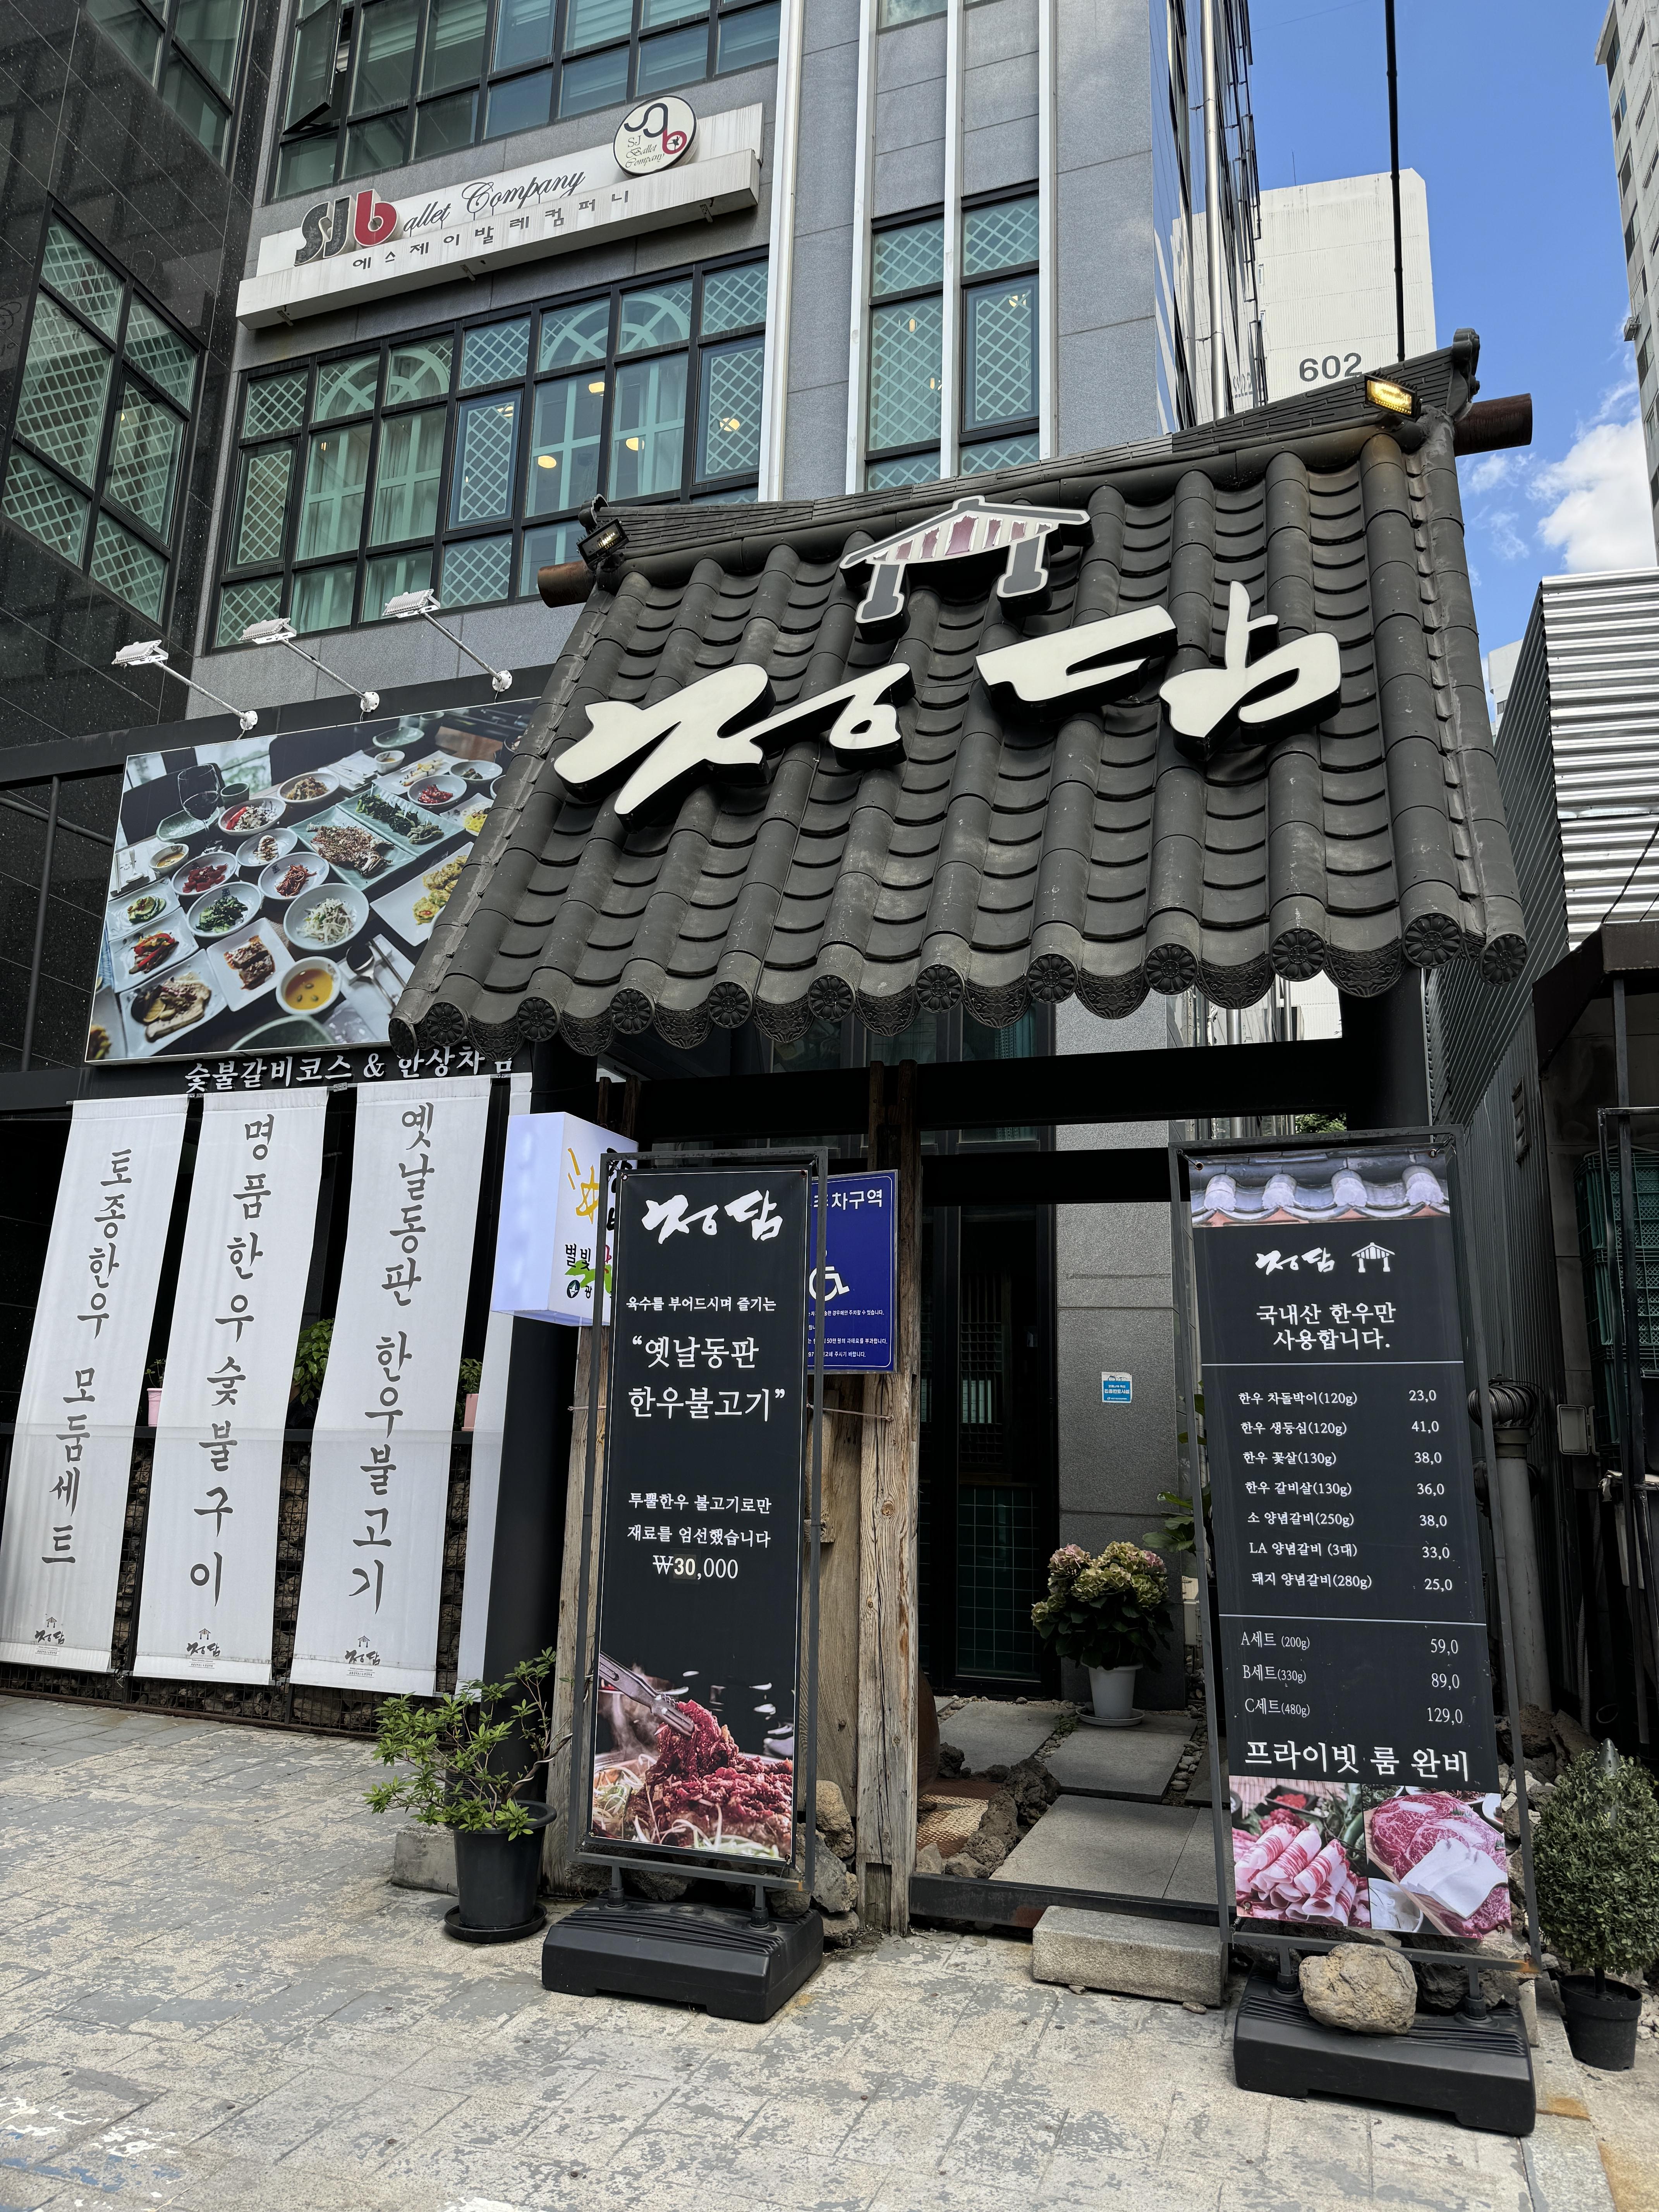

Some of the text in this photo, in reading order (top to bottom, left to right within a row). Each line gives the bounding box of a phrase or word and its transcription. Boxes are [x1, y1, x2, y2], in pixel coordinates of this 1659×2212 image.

[626, 144, 656, 158] Ballet
[628, 136, 641, 148] SJ
[625, 153, 665, 168] Company
[462, 171, 586, 213] Company
[1299, 352, 1362, 382] 602
[554, 581, 1341, 815] 정담
[185, 1055, 353, 1093] 숯불갈비코스
[364, 1054, 384, 1077] &
[382, 1103, 434, 1306] 옛날동판
[642, 1190, 783, 1244] 정담
[1255, 1248, 1334, 1275] 정담
[626, 1297, 776, 1311] 육수를 부어드시며 즐기는
[1257, 1302, 1396, 1325] 국내산 한우만
[1273, 1328, 1389, 1350] 사용합니다.
[42, 1149, 132, 1563] 토종한우 모둠세트
[1238, 1392, 1263, 1405] 한우
[1409, 1390, 1436, 1402] 23,0
[1241, 1422, 1266, 1434] 한우
[1412, 1421, 1439, 1433] 41,0
[1243, 1451, 1267, 1464] 한우
[1415, 1452, 1441, 1465] 38,0
[349, 1331, 412, 1614] 한우불고기
[1245, 1481, 1270, 1494] 한우
[1417, 1484, 1444, 1496] 36,0
[629, 1493, 771, 1514] 투뿔한우 불고기로만
[1248, 1512, 1259, 1522] 소
[1420, 1515, 1447, 1528] 38,0
[627, 1525, 771, 1548] 재료를 엄선했습니다
[1249, 1542, 1449, 1559] LA 양념갈비 (3대) 33,0
[1252, 1572, 1275, 1585] 돼지
[1425, 1578, 1452, 1592] 25,0
[1241, 1631, 1458, 1656] A세트 (200g) 59,0
[1432, 1673, 1459, 1690] 89,0
[1427, 1707, 1462, 1725] 129,0
[1245, 1740, 1468, 1781] 프라이빗 룸 완비
